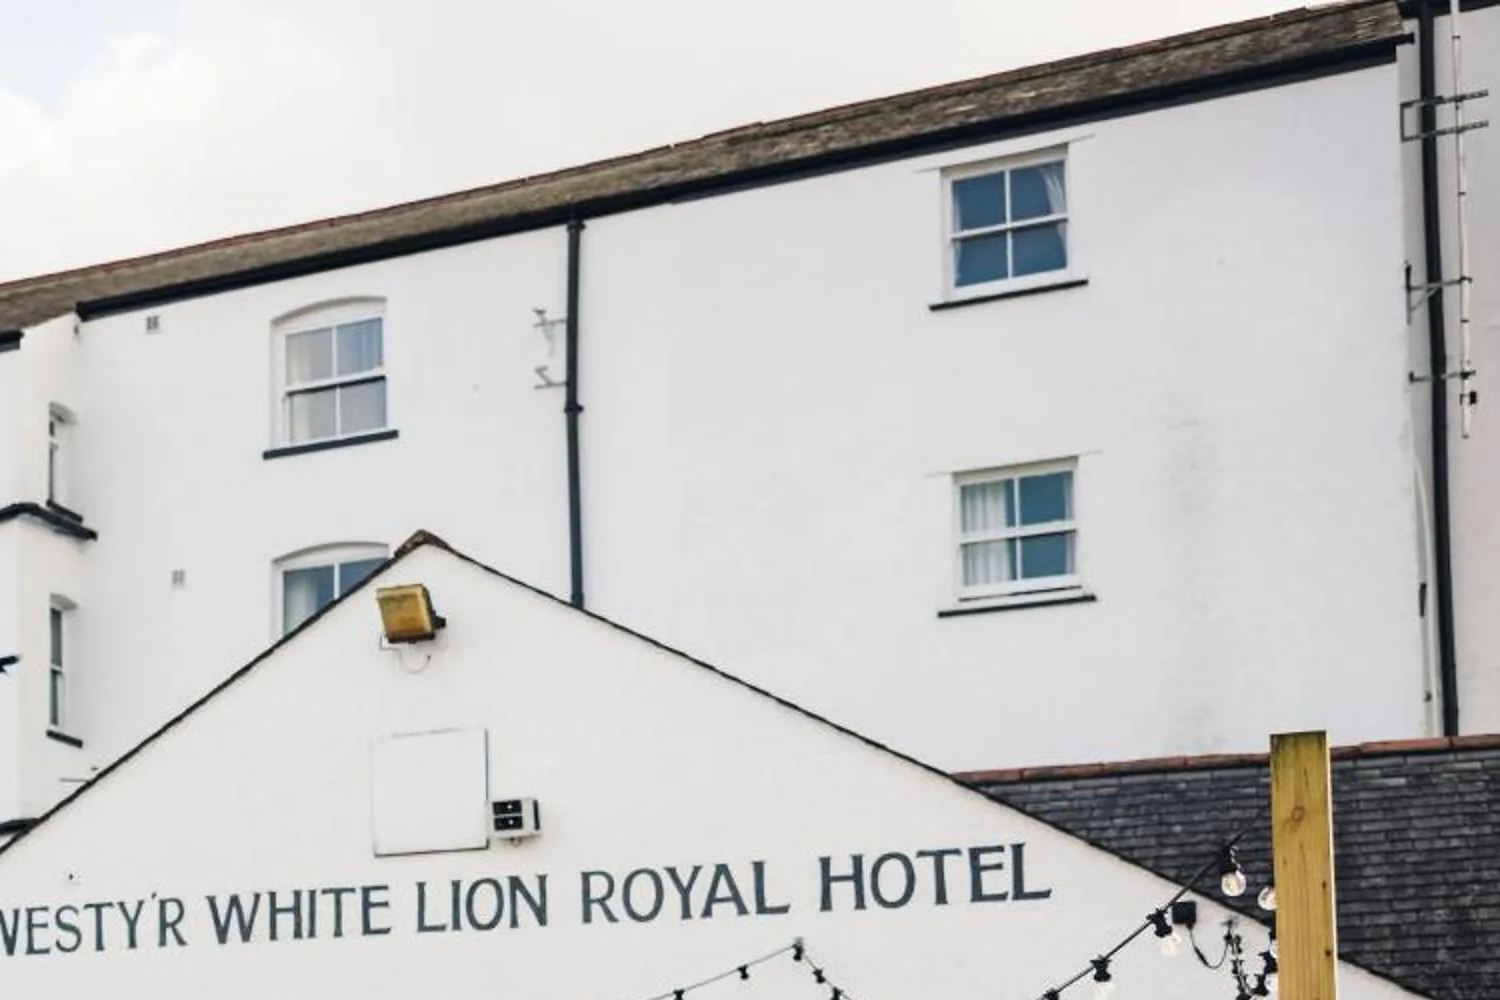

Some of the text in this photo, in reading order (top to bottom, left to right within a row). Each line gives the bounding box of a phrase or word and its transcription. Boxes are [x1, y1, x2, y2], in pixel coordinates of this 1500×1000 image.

[205, 885, 393, 945] WHITE
[415, 873, 548, 933] LION
[580, 859, 791, 925] ROYAL
[817, 841, 1053, 913] HOTEL
